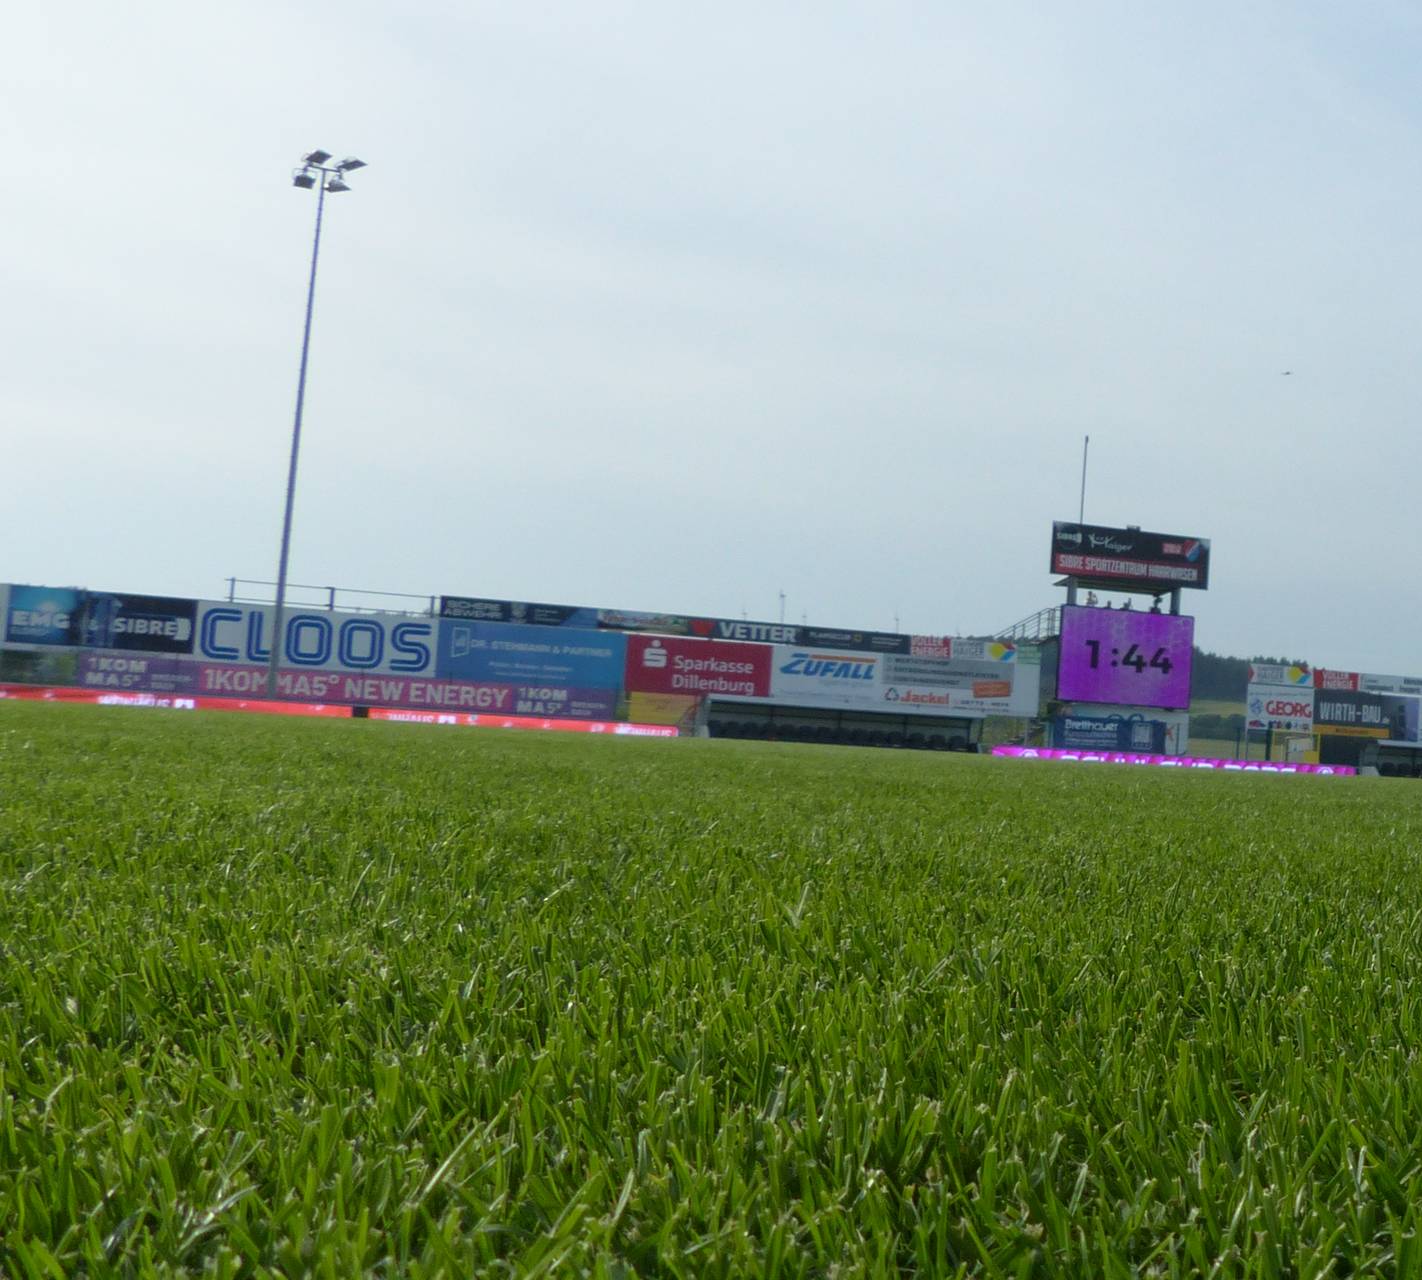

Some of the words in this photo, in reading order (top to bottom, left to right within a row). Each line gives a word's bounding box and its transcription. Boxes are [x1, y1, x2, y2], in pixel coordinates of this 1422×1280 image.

[1085, 557, 1147, 576] SPORTZENTRUM
[112, 617, 177, 638] SIBRE
[719, 621, 798, 642] VETTER
[201, 608, 432, 672] CLOOS
[673, 655, 754, 674] Sparkasse
[779, 653, 875, 680] ZUFALL
[1085, 640, 1174, 675] 1:44
[344, 678, 405, 702] NEW
[410, 682, 509, 709] ENERGY
[672, 673, 755, 695] Dillenburg
[1265, 700, 1312, 718] GEORG
[1319, 700, 1382, 723] WIRTH-BAU
